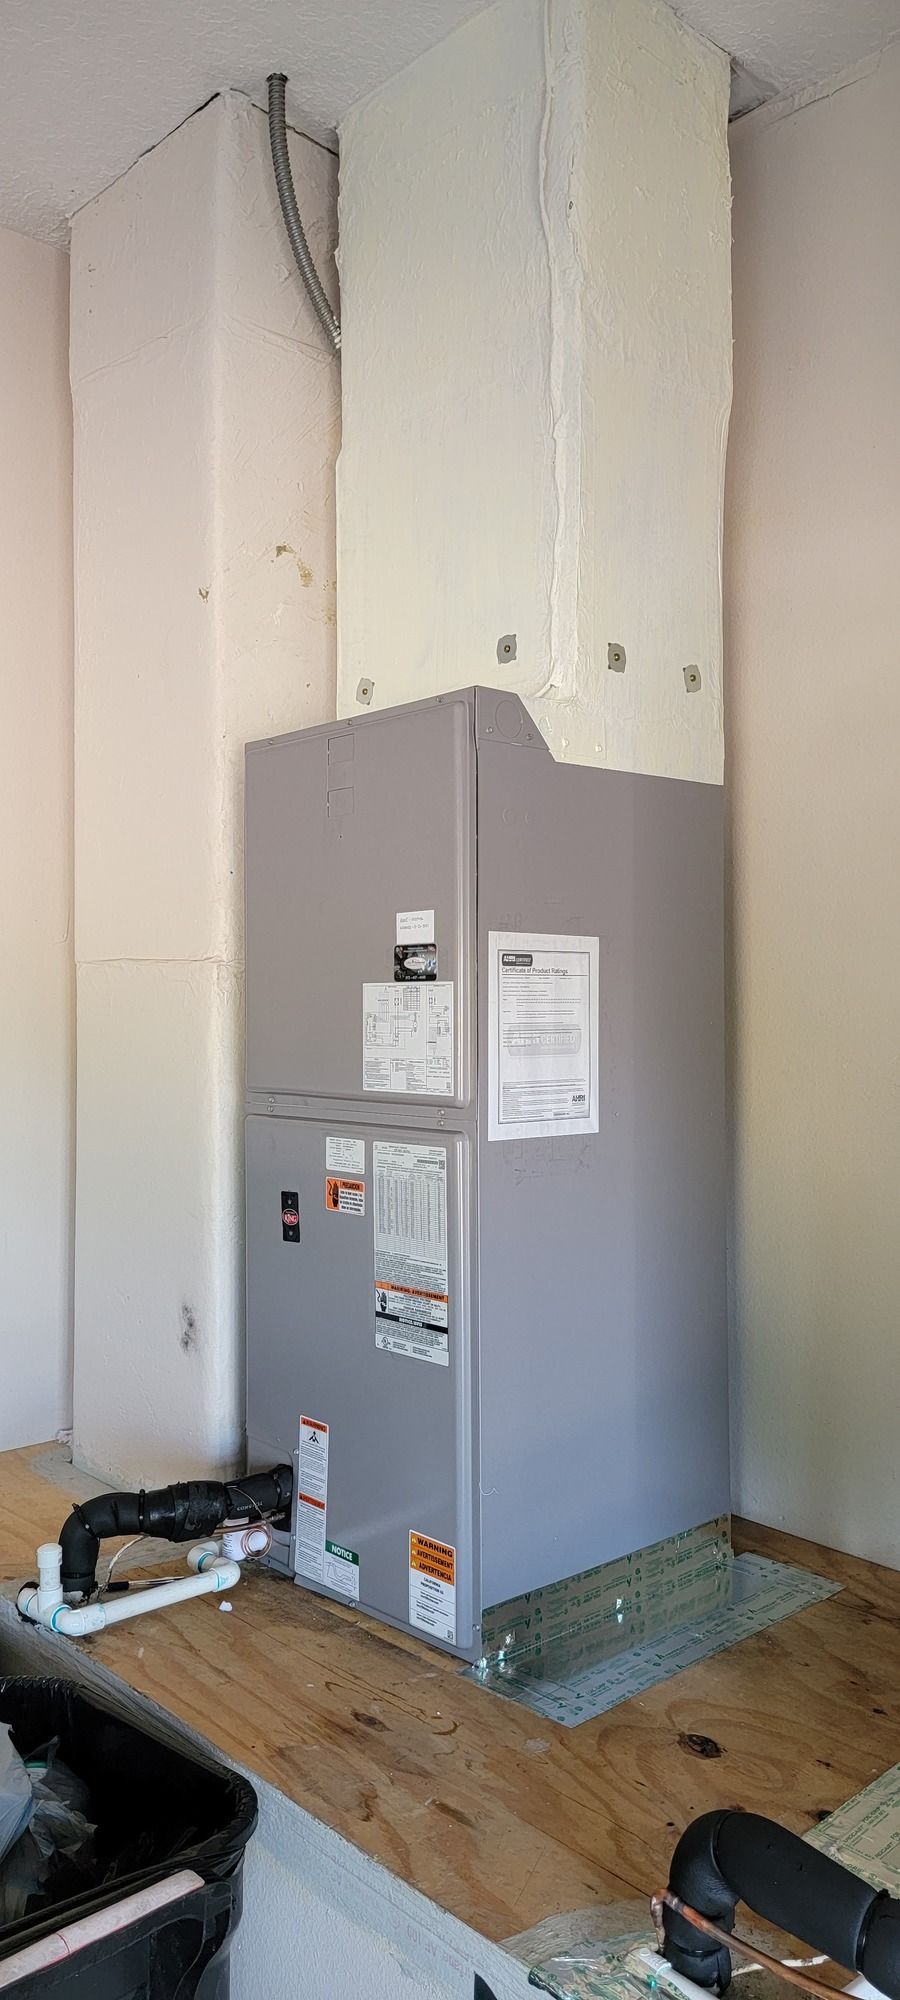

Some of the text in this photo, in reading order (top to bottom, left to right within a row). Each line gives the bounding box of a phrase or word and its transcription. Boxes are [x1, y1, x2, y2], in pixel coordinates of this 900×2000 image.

[551, 967, 569, 975] Ratings
[331, 1544, 353, 1561] NOTICE
[417, 1538, 453, 1558] WARNING
[417, 1549, 453, 1570] AVERTISSEMENT
[419, 1562, 452, 1582] ADVERTENCIA
